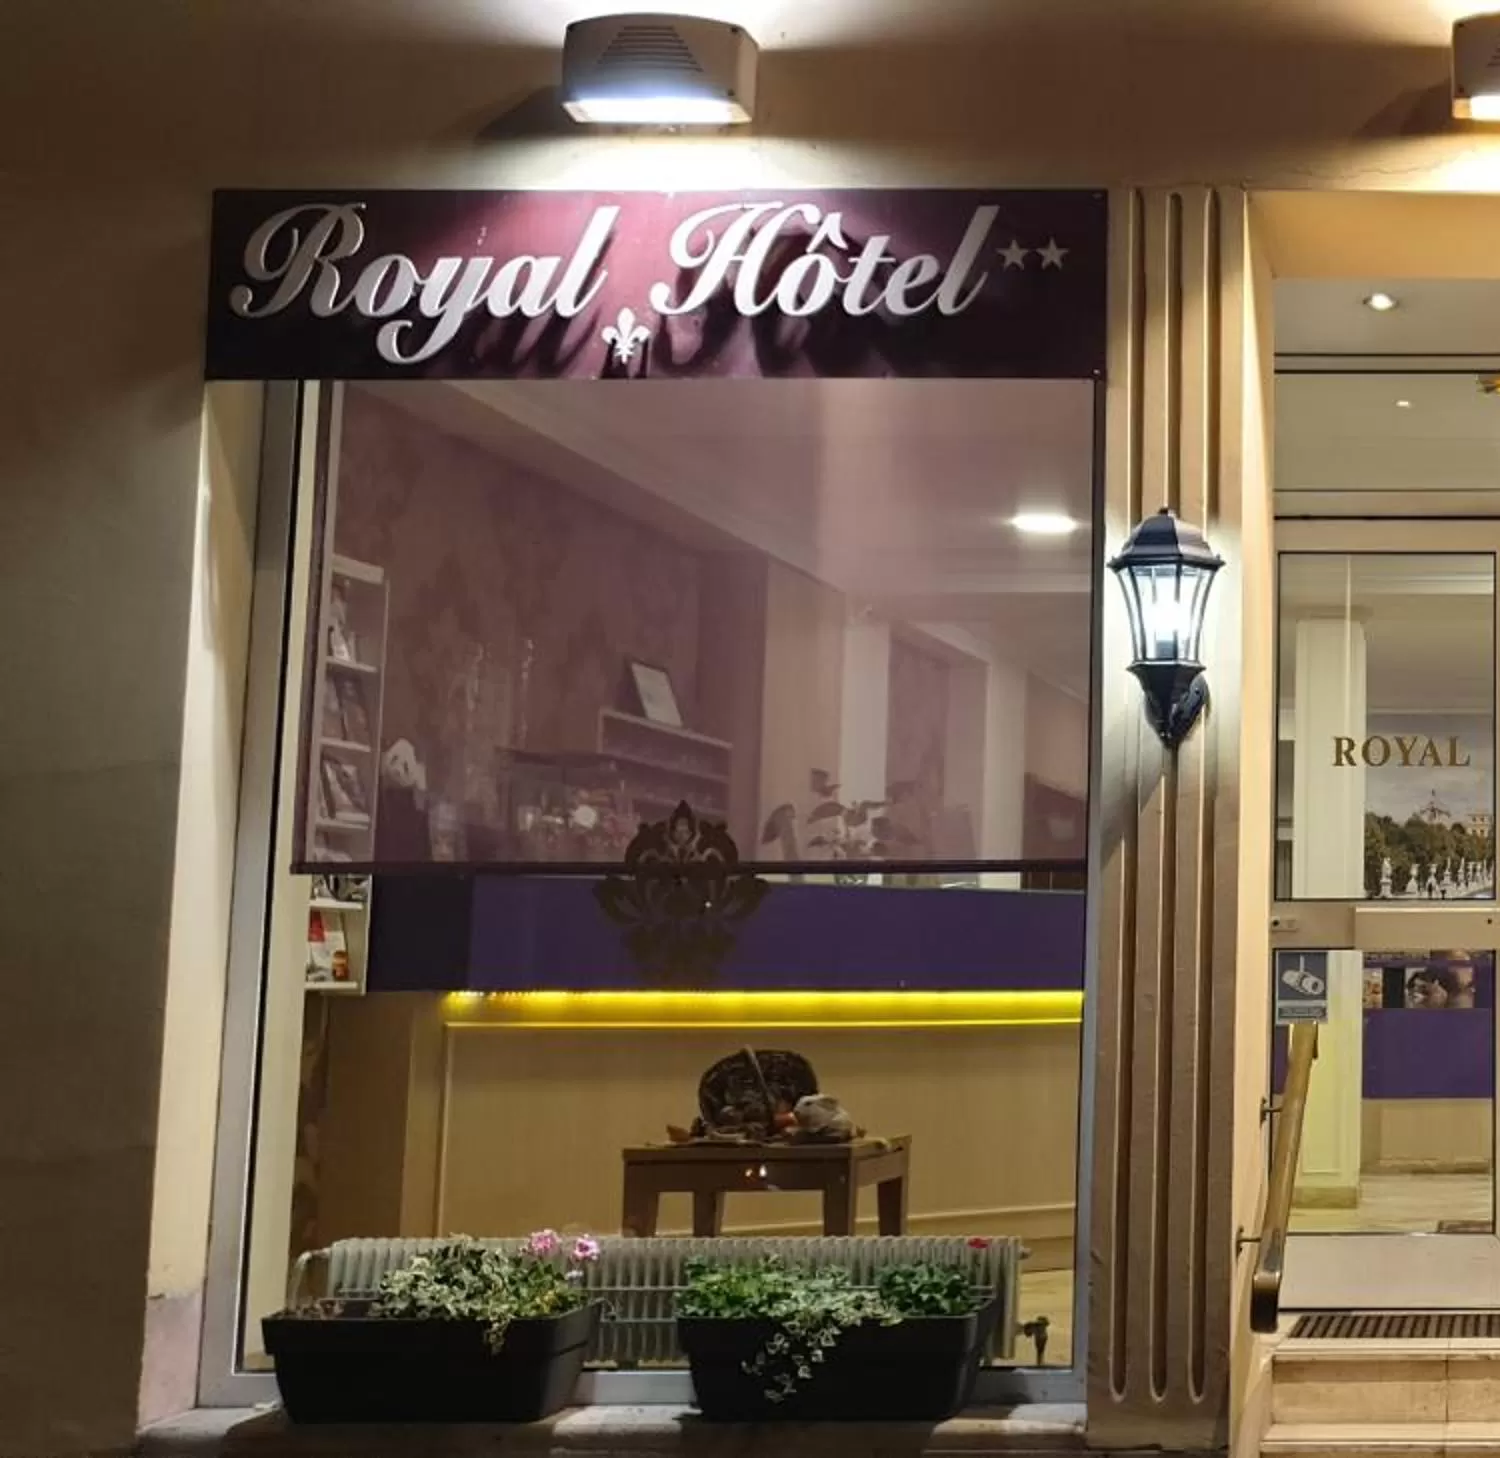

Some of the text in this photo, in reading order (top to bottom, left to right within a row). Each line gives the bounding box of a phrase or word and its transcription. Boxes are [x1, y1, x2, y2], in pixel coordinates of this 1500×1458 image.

[230, 202, 1000, 364] Royal Hôtel
[1332, 735, 1471, 767] ROYAL
